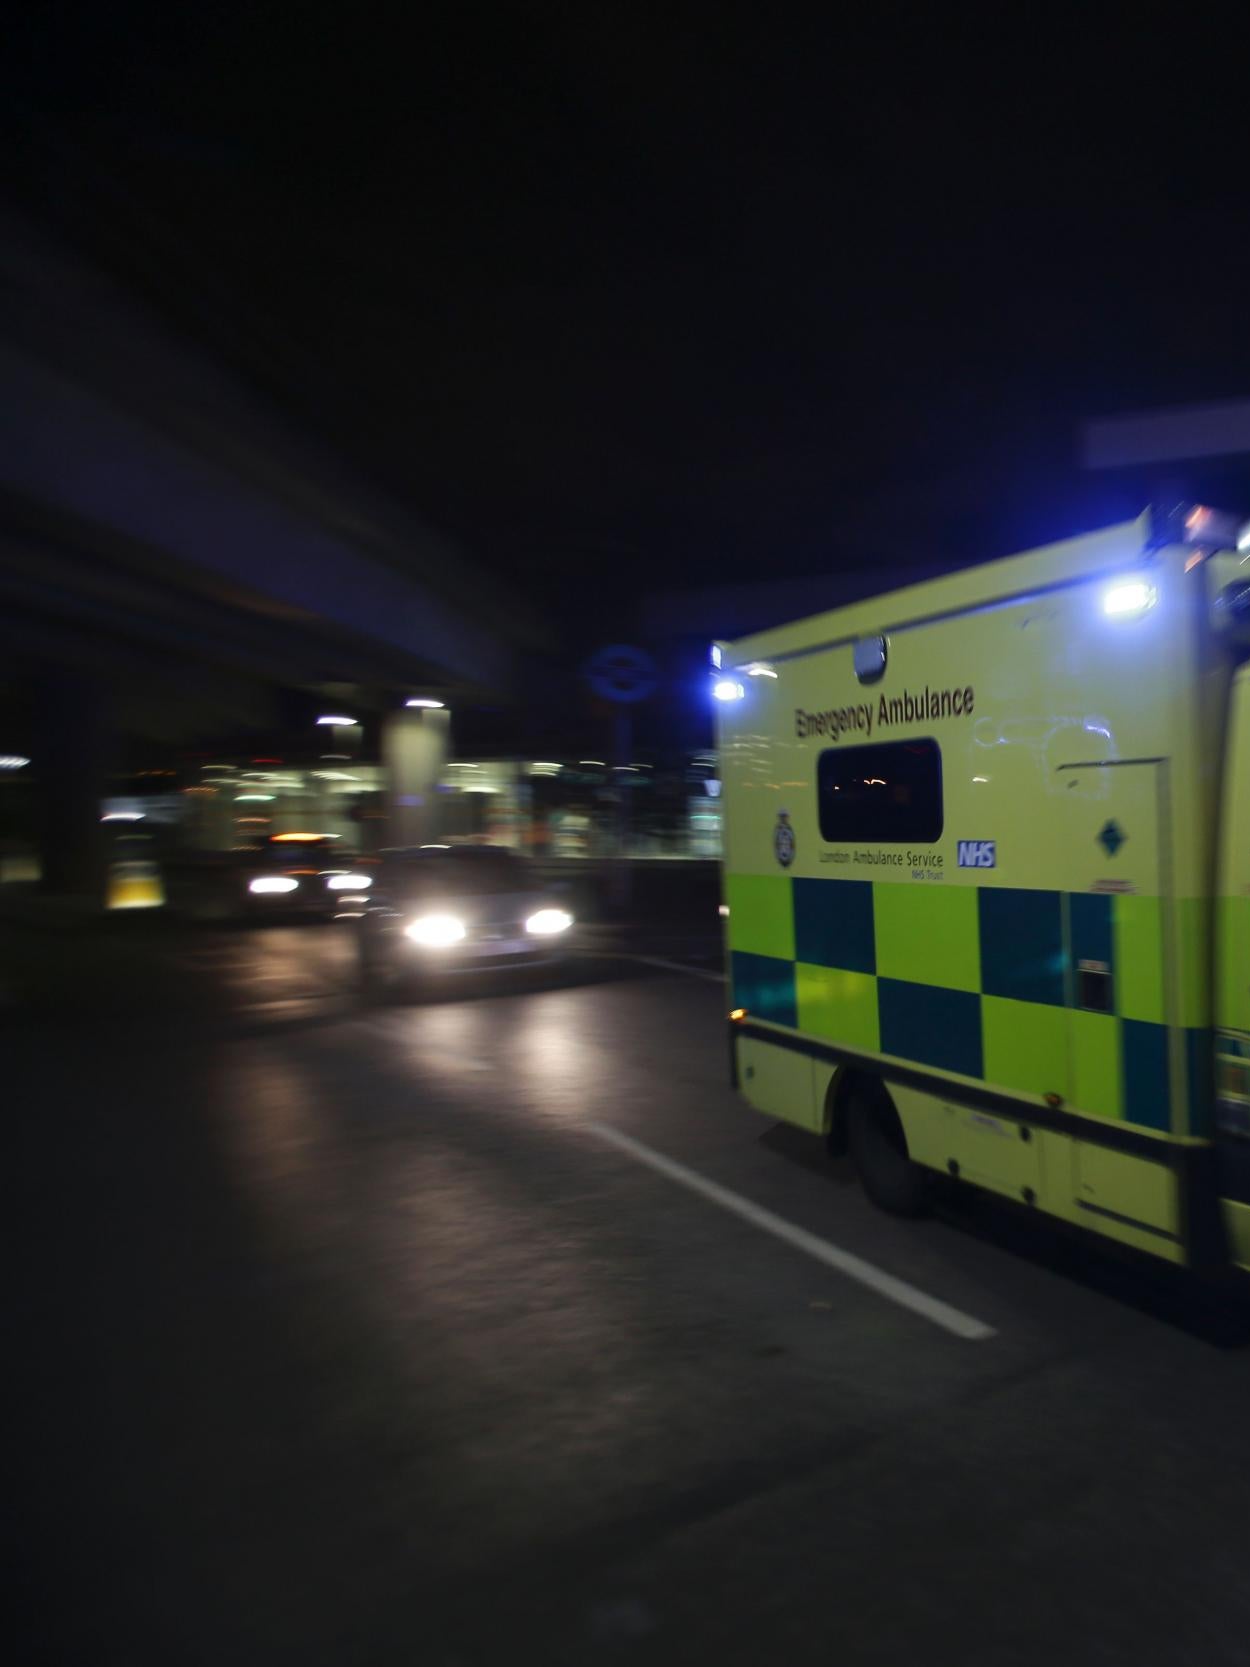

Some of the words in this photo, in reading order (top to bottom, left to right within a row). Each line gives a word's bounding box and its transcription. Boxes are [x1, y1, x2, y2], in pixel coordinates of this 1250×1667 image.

[795, 704, 874, 741] Emergency
[879, 685, 974, 726] Ambulance
[819, 850, 851, 864] London
[853, 850, 903, 866] Ambulance
[906, 851, 944, 868] Service
[958, 842, 995, 867] NHS
[911, 870, 925, 880] NHS
[926, 870, 944, 880] Trust
